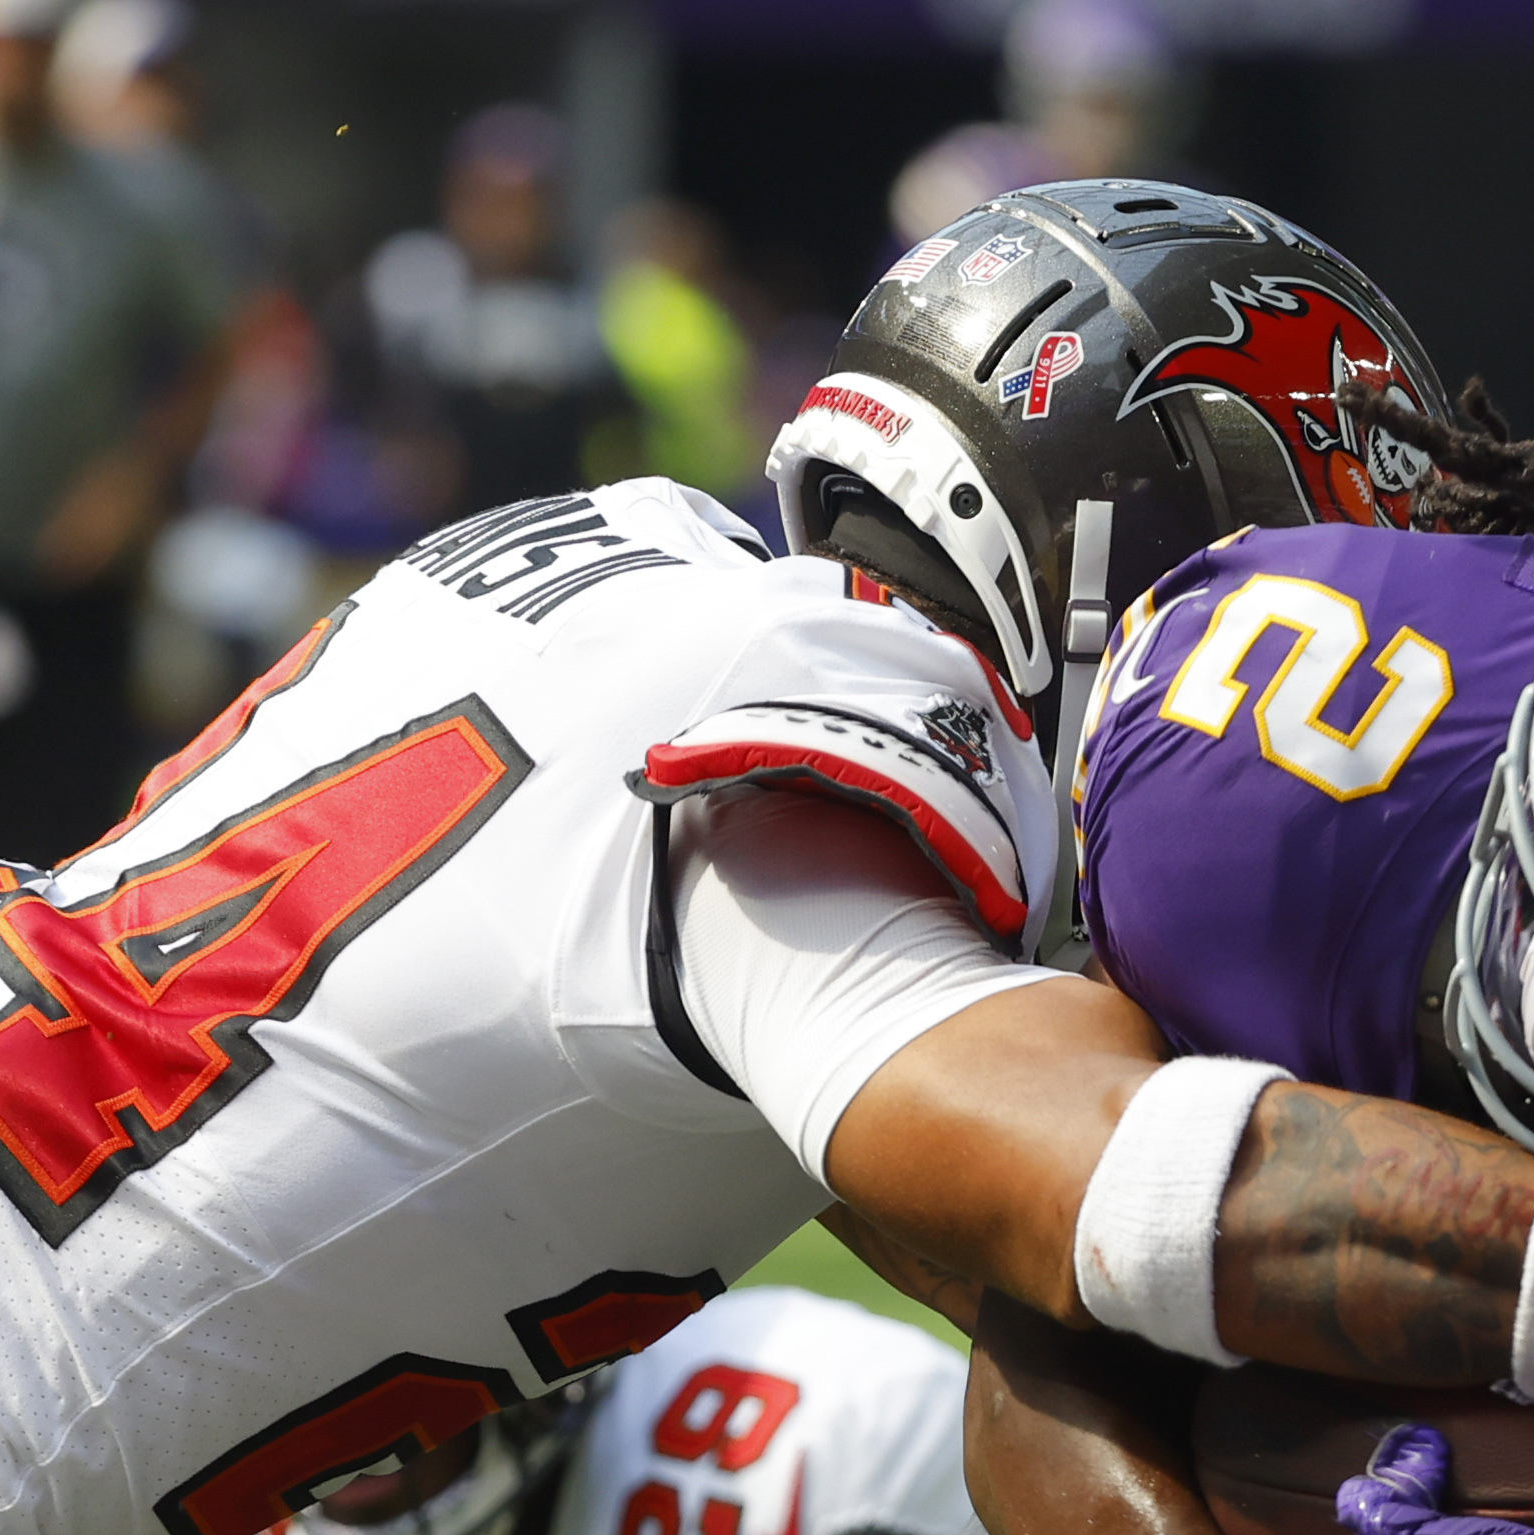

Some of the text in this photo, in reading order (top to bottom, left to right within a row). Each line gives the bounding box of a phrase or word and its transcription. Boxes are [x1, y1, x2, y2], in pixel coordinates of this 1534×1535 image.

[965, 251, 1004, 279] NFL
[1034, 357, 1051, 388] 9/11
[1159, 573, 1454, 802] 2
